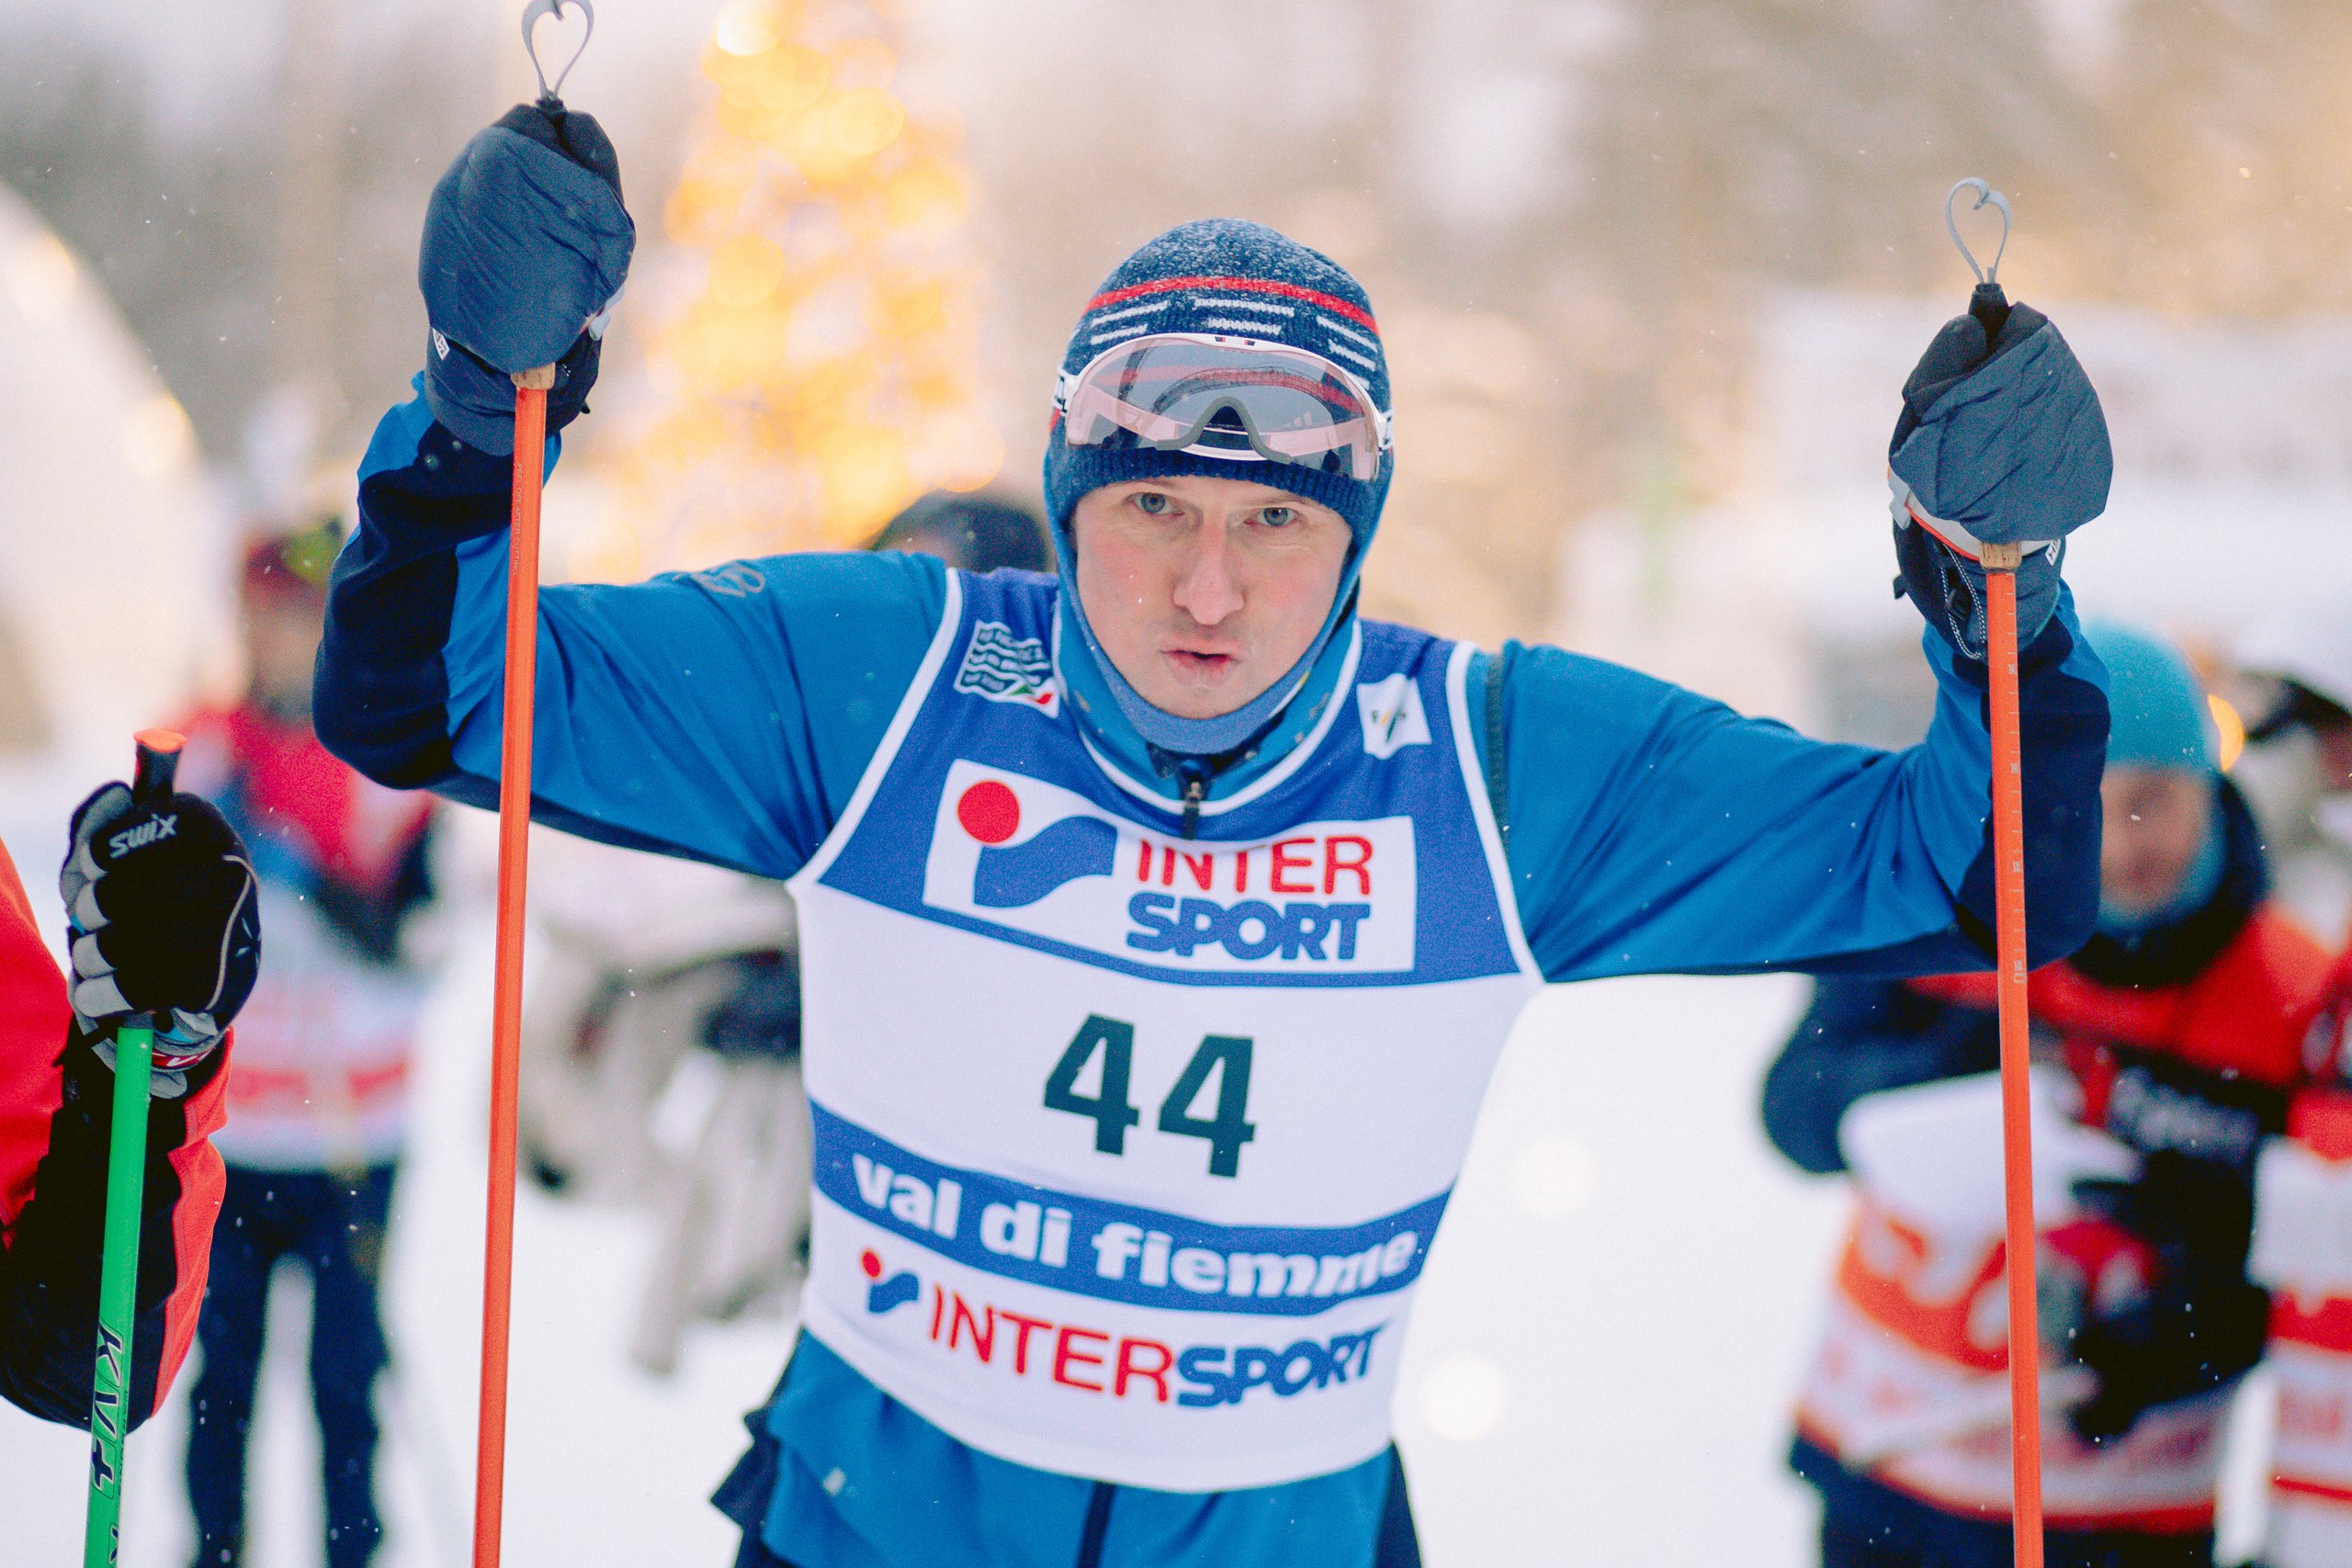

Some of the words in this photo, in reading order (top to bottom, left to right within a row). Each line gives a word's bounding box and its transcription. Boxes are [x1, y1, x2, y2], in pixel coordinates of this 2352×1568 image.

[1126, 892, 1370, 960] SPORT
[1137, 836, 1374, 895] INTER
[1044, 1012, 1256, 1178] 44
[853, 1154, 962, 1238] val
[980, 1201, 1072, 1268] di
[1092, 1223, 1419, 1298] fiemme
[929, 1284, 1392, 1408] INTERSPORT
